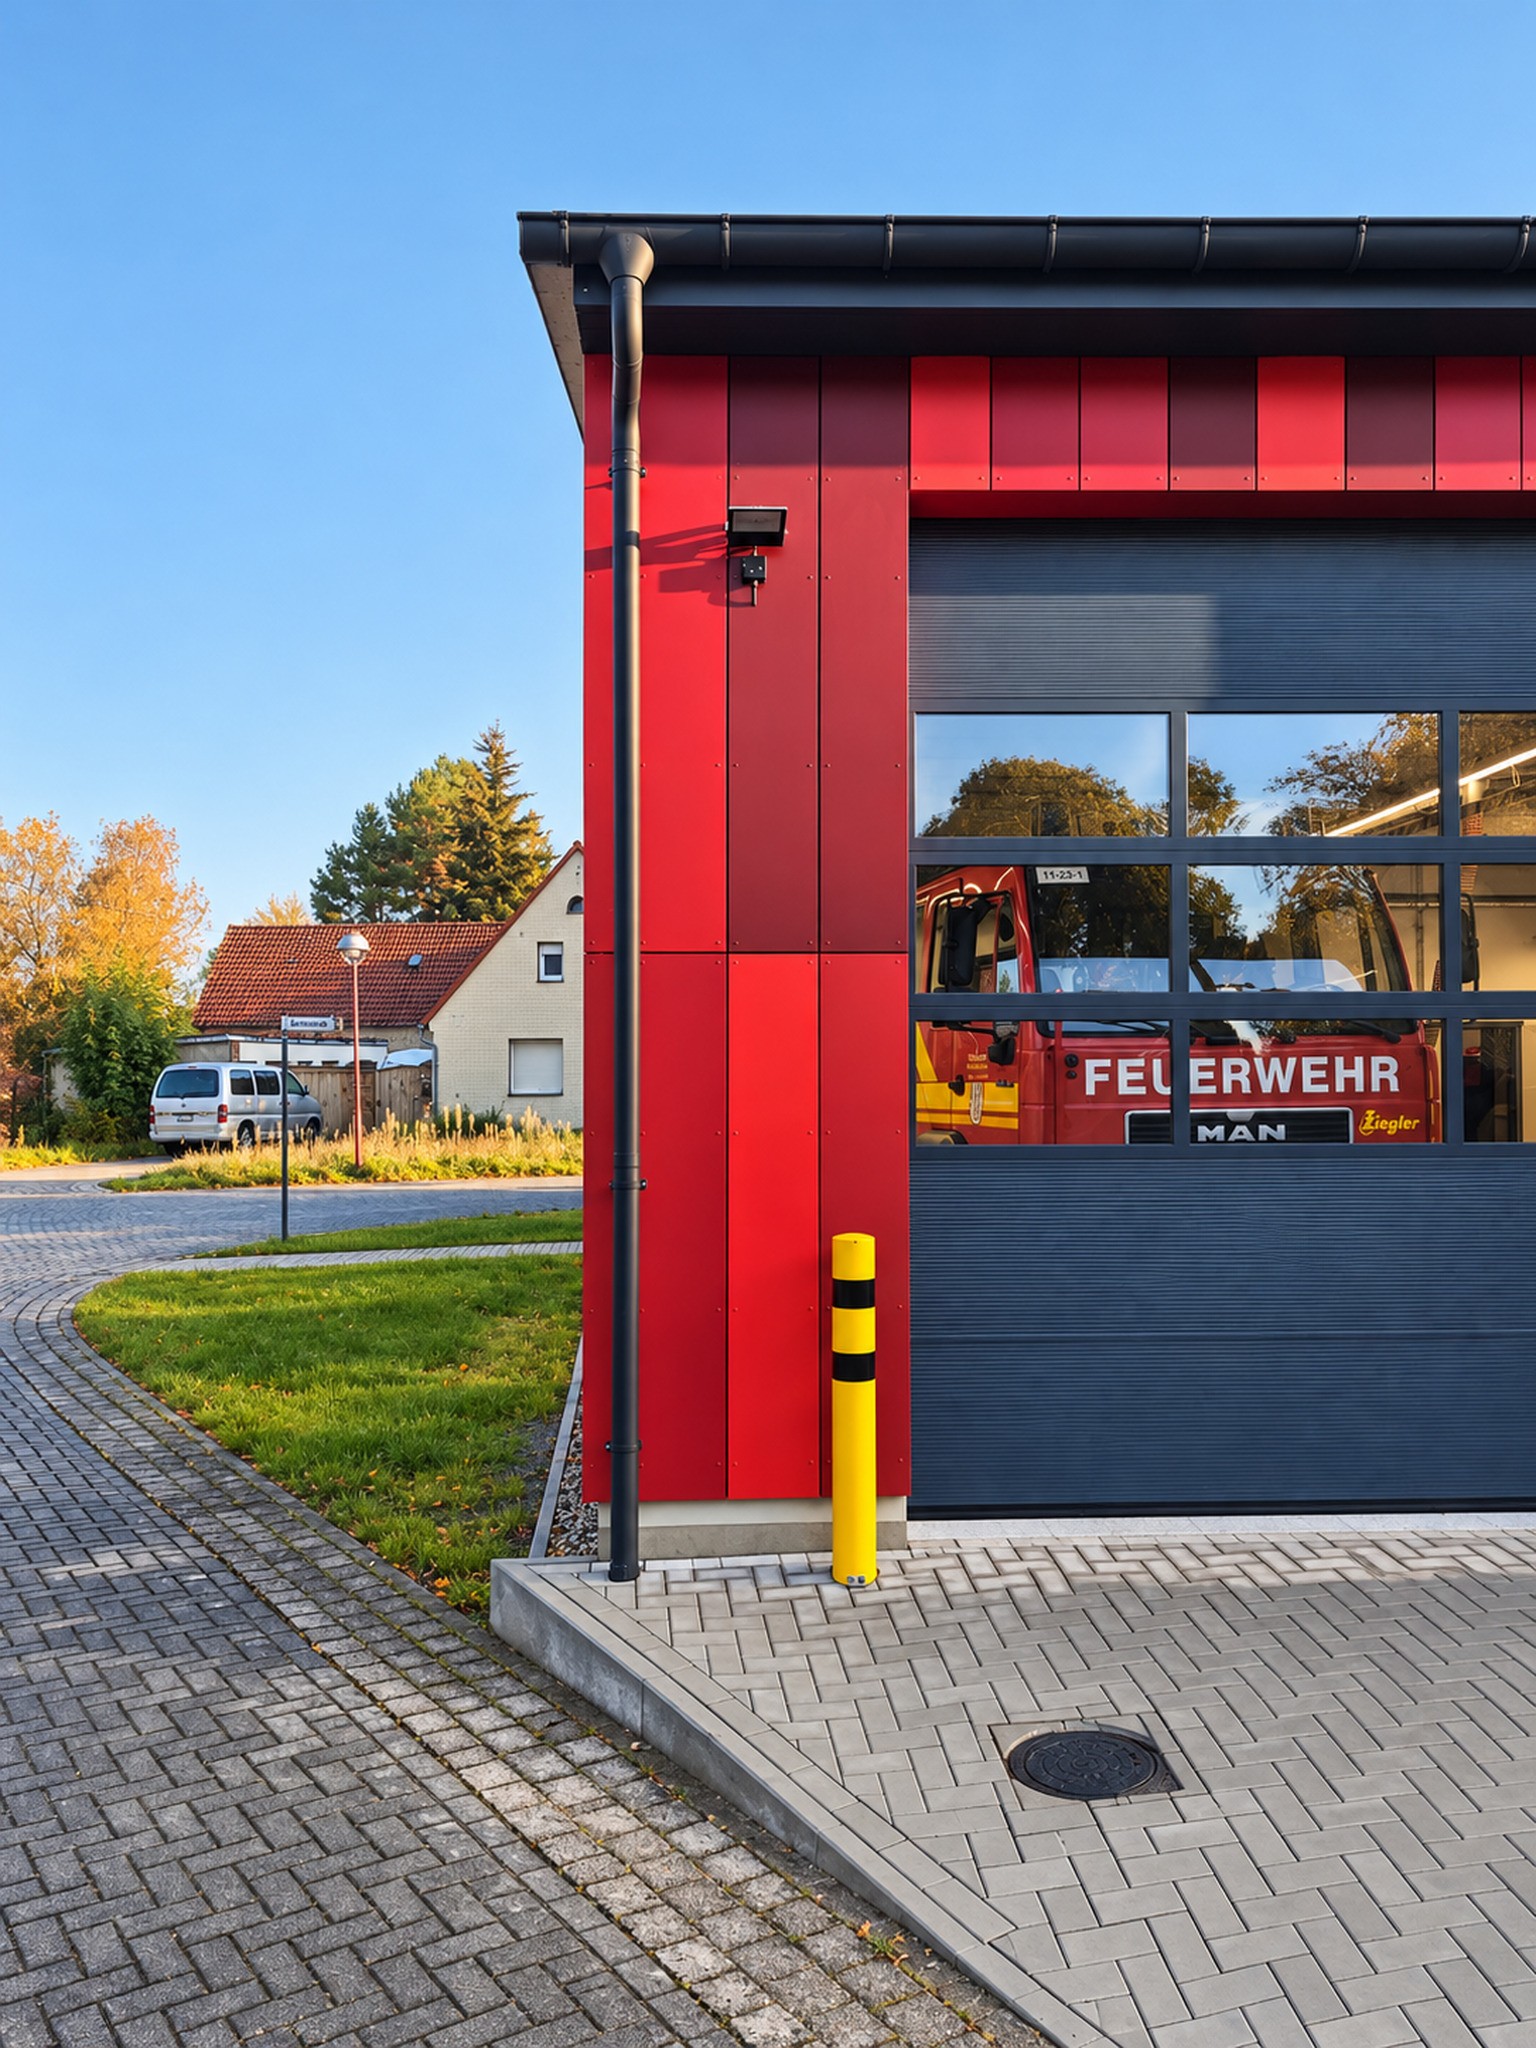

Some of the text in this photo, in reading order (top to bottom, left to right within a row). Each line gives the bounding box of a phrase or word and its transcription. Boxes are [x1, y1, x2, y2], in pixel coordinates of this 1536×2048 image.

[1085, 1056, 1400, 1096] FEUERWEHR
[1197, 1124, 1286, 1142] MAN
[1359, 1109, 1421, 1136] Ziegler
